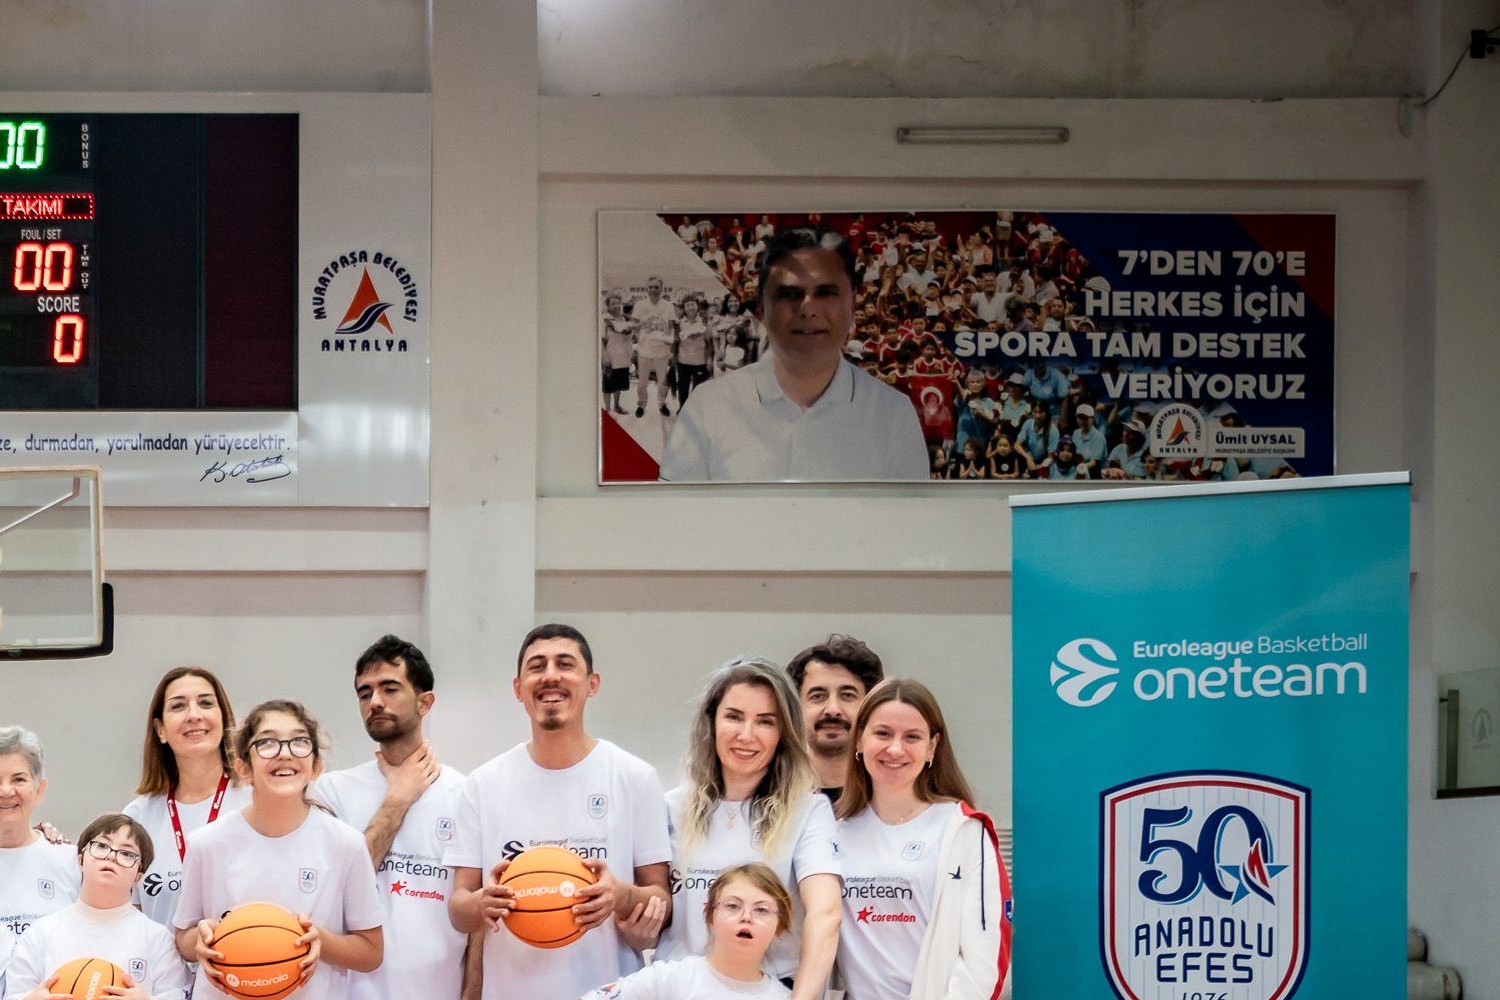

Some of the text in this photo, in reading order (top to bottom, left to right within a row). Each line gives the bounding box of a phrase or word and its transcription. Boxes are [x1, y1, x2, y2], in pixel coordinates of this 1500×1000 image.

[81, 123, 89, 169] BONUS
[20, 229, 42, 240] FOUL
[46, 229, 62, 240] SET
[13, 243, 73, 291] 00
[80, 244, 90, 289] TIME OUT
[1117, 250, 1306, 276] 7'DEN 70'E
[312, 250, 418, 322] MURATPAŞA BELEDİYESİ
[37, 296, 80, 313] SCORE
[1085, 284, 1306, 324] HERKES İÇİN
[52, 315, 84, 363] 0
[321, 339, 408, 352] ANTALYA
[953, 331, 1307, 359] SPORA TAM DESTEK
[1101, 366, 1306, 400] VERİYORUZ
[24, 433, 99, 453] durmadan,
[106, 433, 188, 455] yorulmadan
[195, 433, 291, 455] yürüyecektir.
[1215, 431, 1296, 445] Ümit UYSAL
[1133, 633, 1368, 661] Euroleague Basketball
[1133, 657, 1368, 701] oneteam
[1138, 805, 1274, 906] 50
[404, 888, 445, 902] corendon
[871, 911, 917, 923] corendon
[1134, 915, 1274, 958] ANADOLU
[240, 973, 290, 988] motorola
[1156, 952, 1254, 984] EFES
